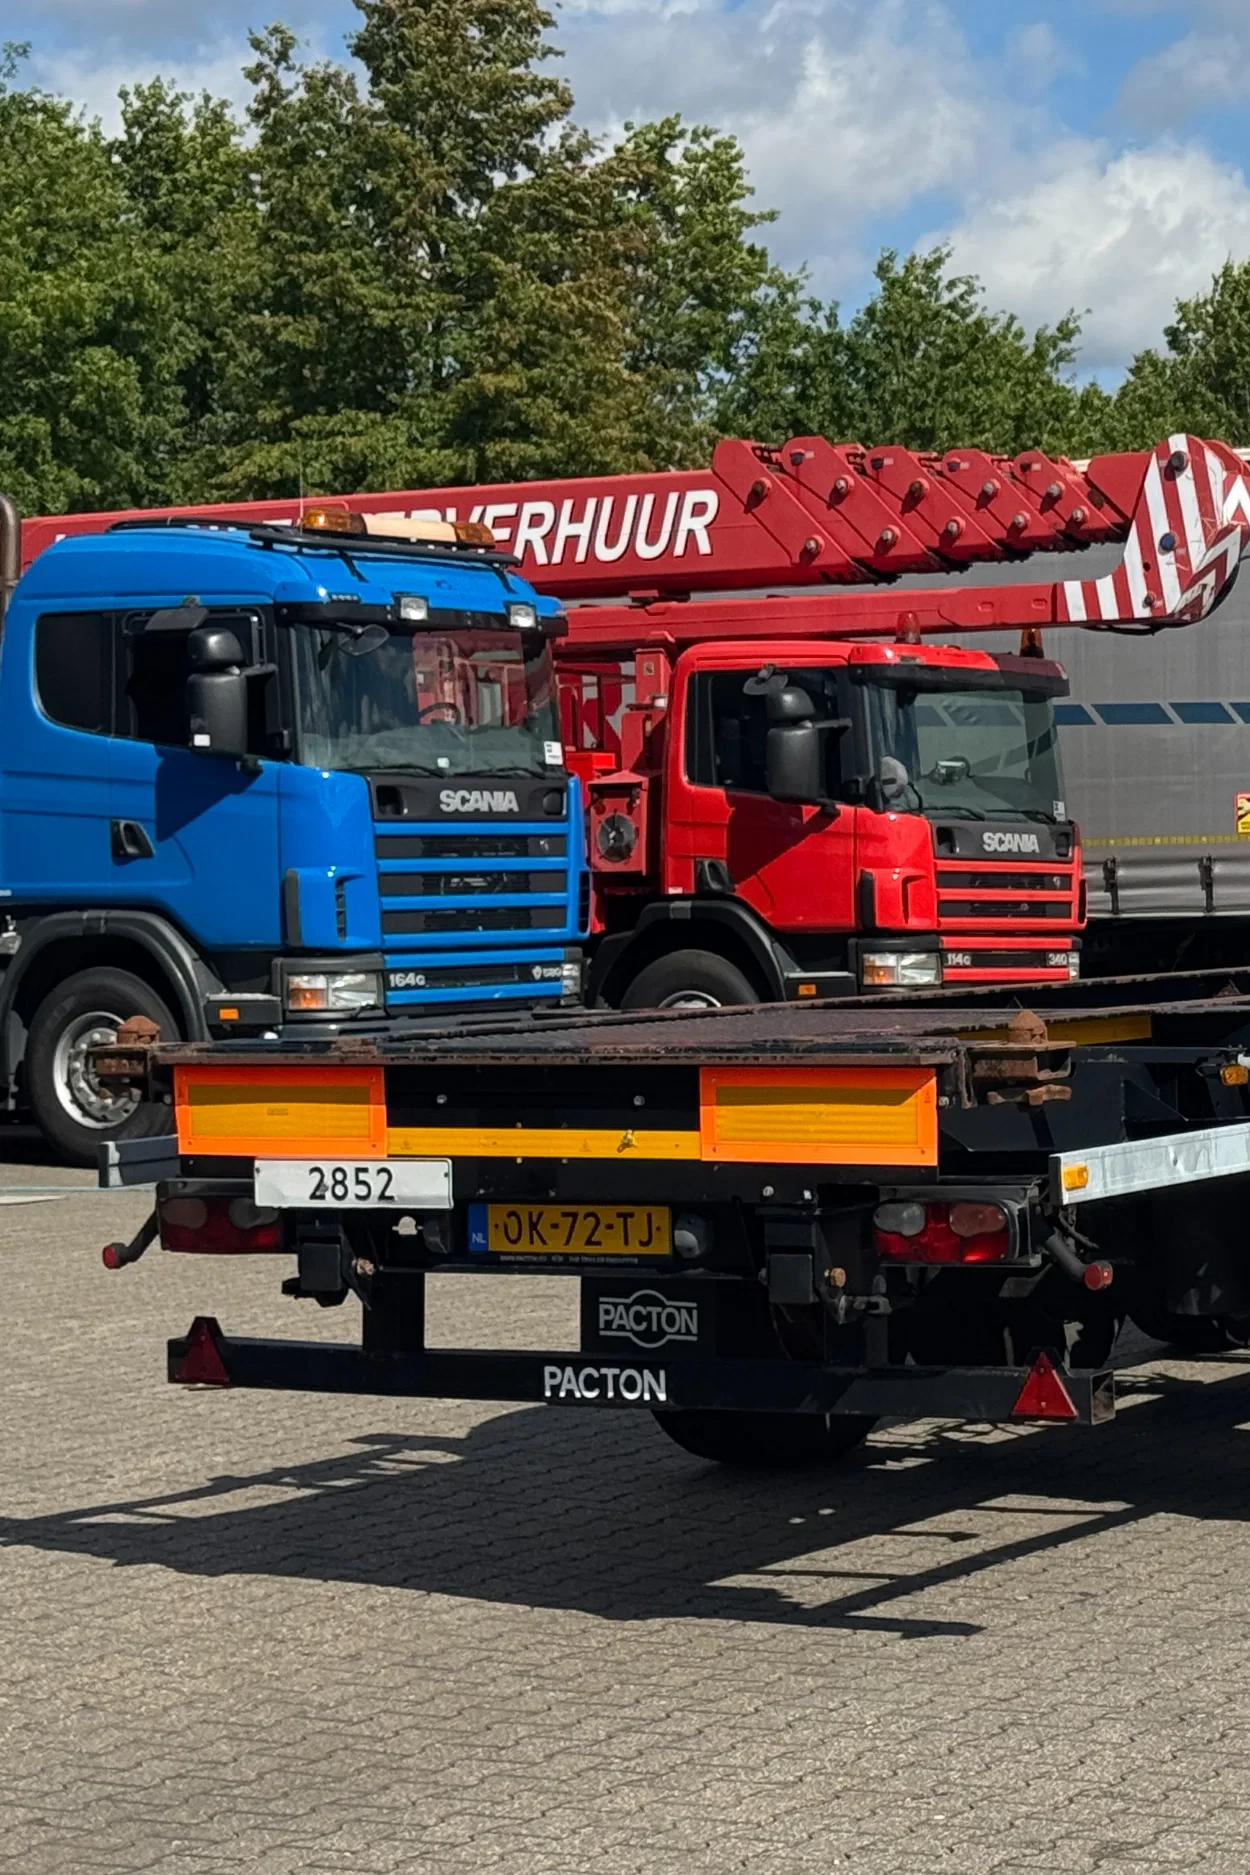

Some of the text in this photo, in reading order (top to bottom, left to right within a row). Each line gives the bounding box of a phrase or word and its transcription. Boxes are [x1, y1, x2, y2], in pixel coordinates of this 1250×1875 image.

[440, 790, 519, 813] SCANIA
[982, 832, 1040, 853] SCANIA
[1048, 953, 1067, 966] 340
[389, 973, 426, 987] 164G
[308, 1166, 396, 1202] 2852
[472, 1232, 486, 1244] NL
[503, 1210, 653, 1248] OK-72-TJ
[599, 1303, 698, 1335] PACTON
[544, 1365, 667, 1402] PACTON
